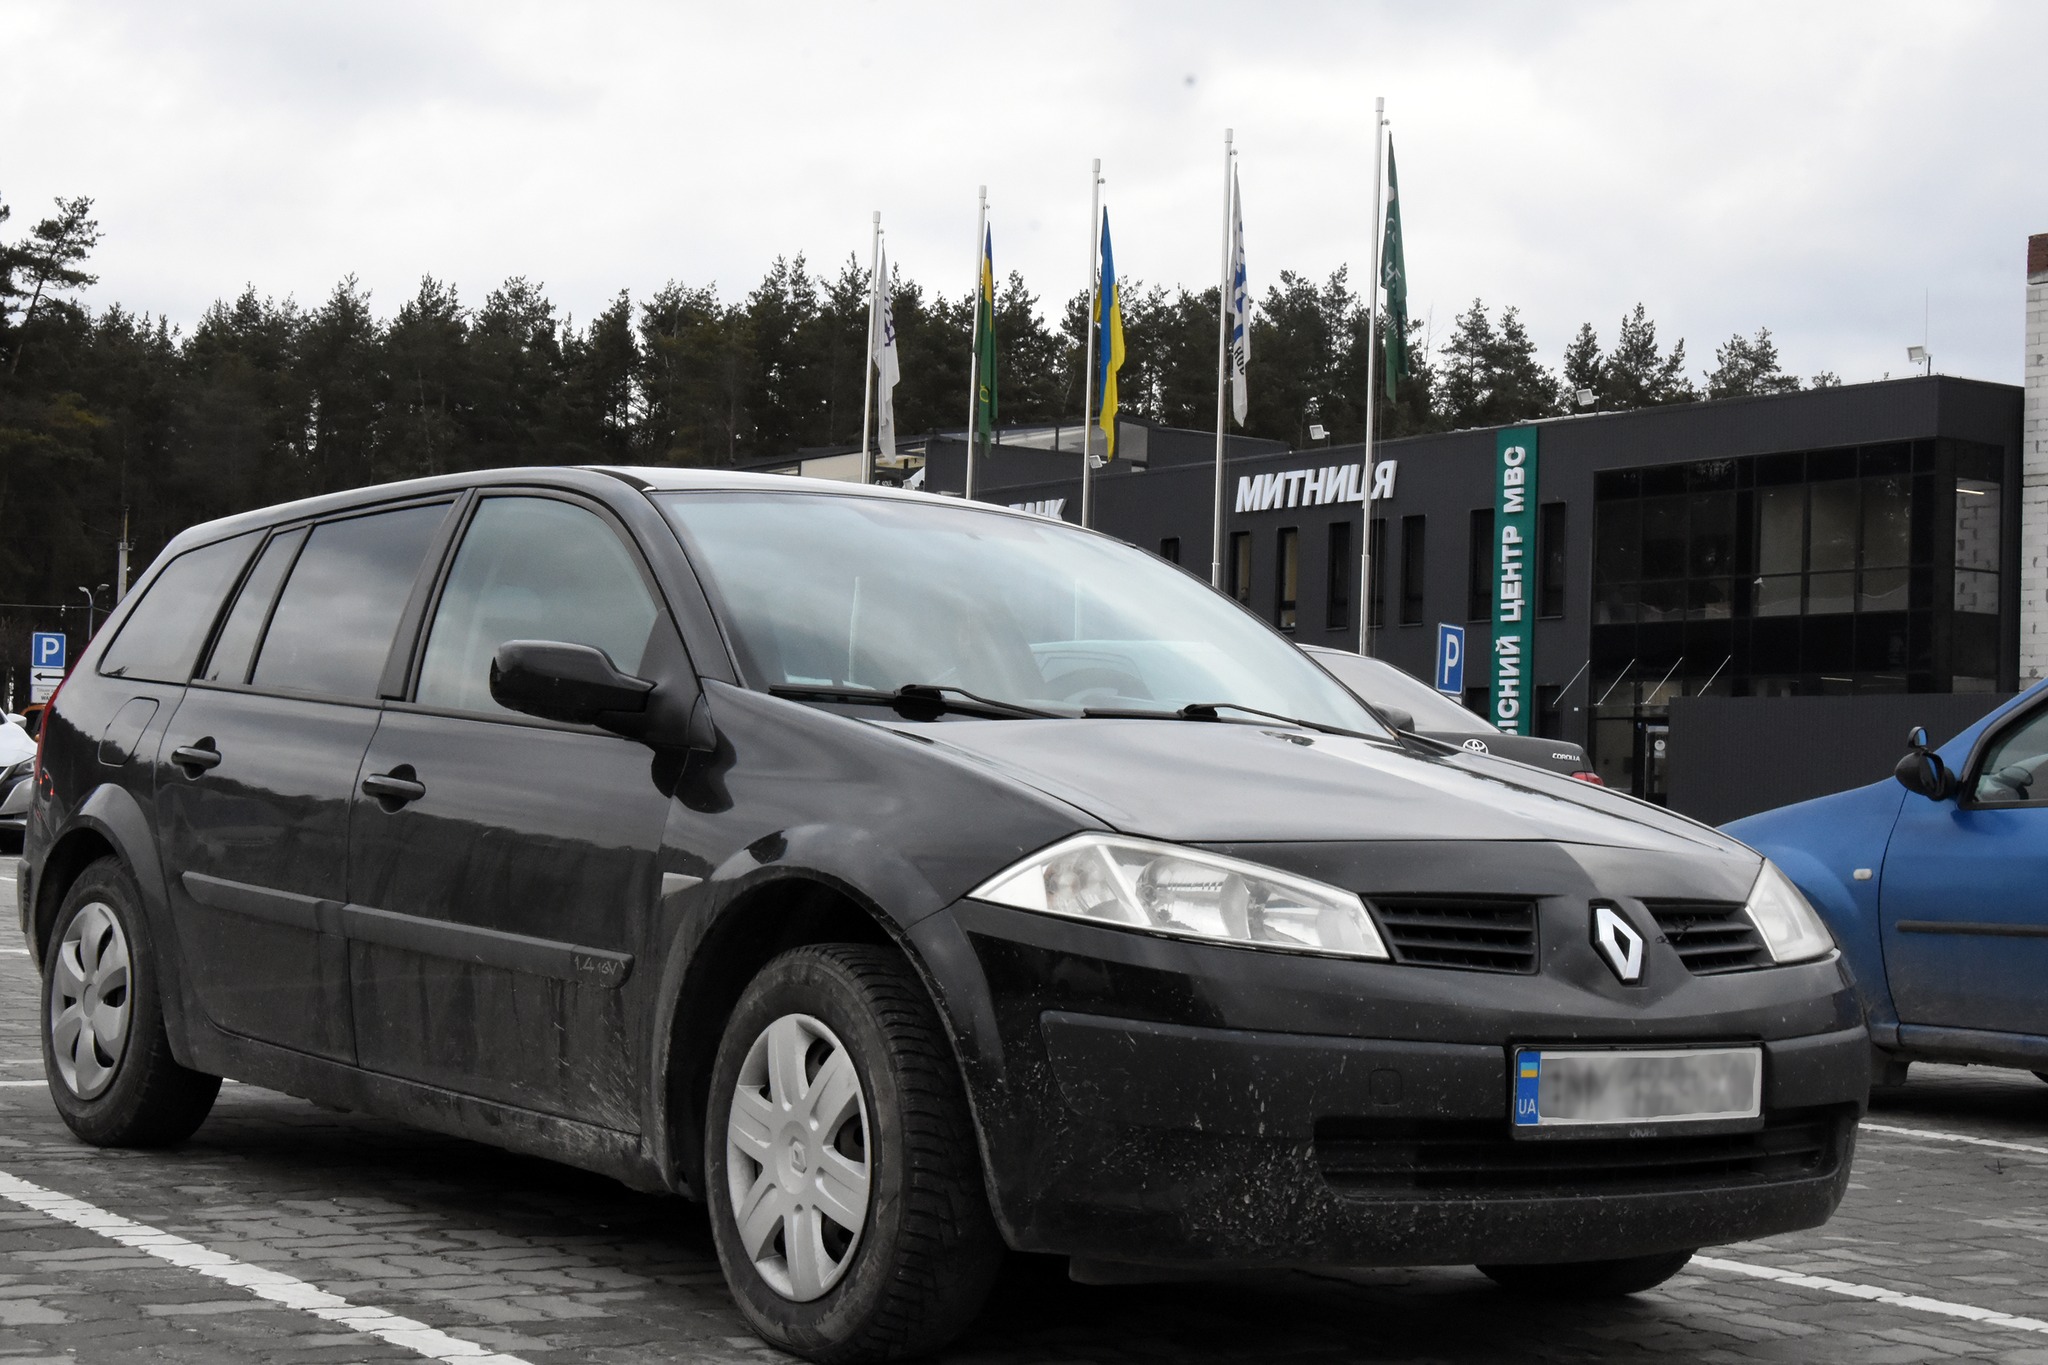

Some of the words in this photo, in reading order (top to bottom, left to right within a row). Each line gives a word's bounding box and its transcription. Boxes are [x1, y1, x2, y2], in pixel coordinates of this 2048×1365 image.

[1235, 460, 1397, 509] МИТНИЦЯ
[1503, 446, 1525, 513] МВС
[1500, 525, 1524, 621] ЦЕНТР
[42, 637, 59, 663] P
[1444, 634, 1459, 684] P
[1495, 636, 1520, 736] ІСНИЙ
[1552, 753, 1580, 761] COROLLA
[574, 955, 595, 973] 1.4
[1518, 1098, 1536, 1115] UA
